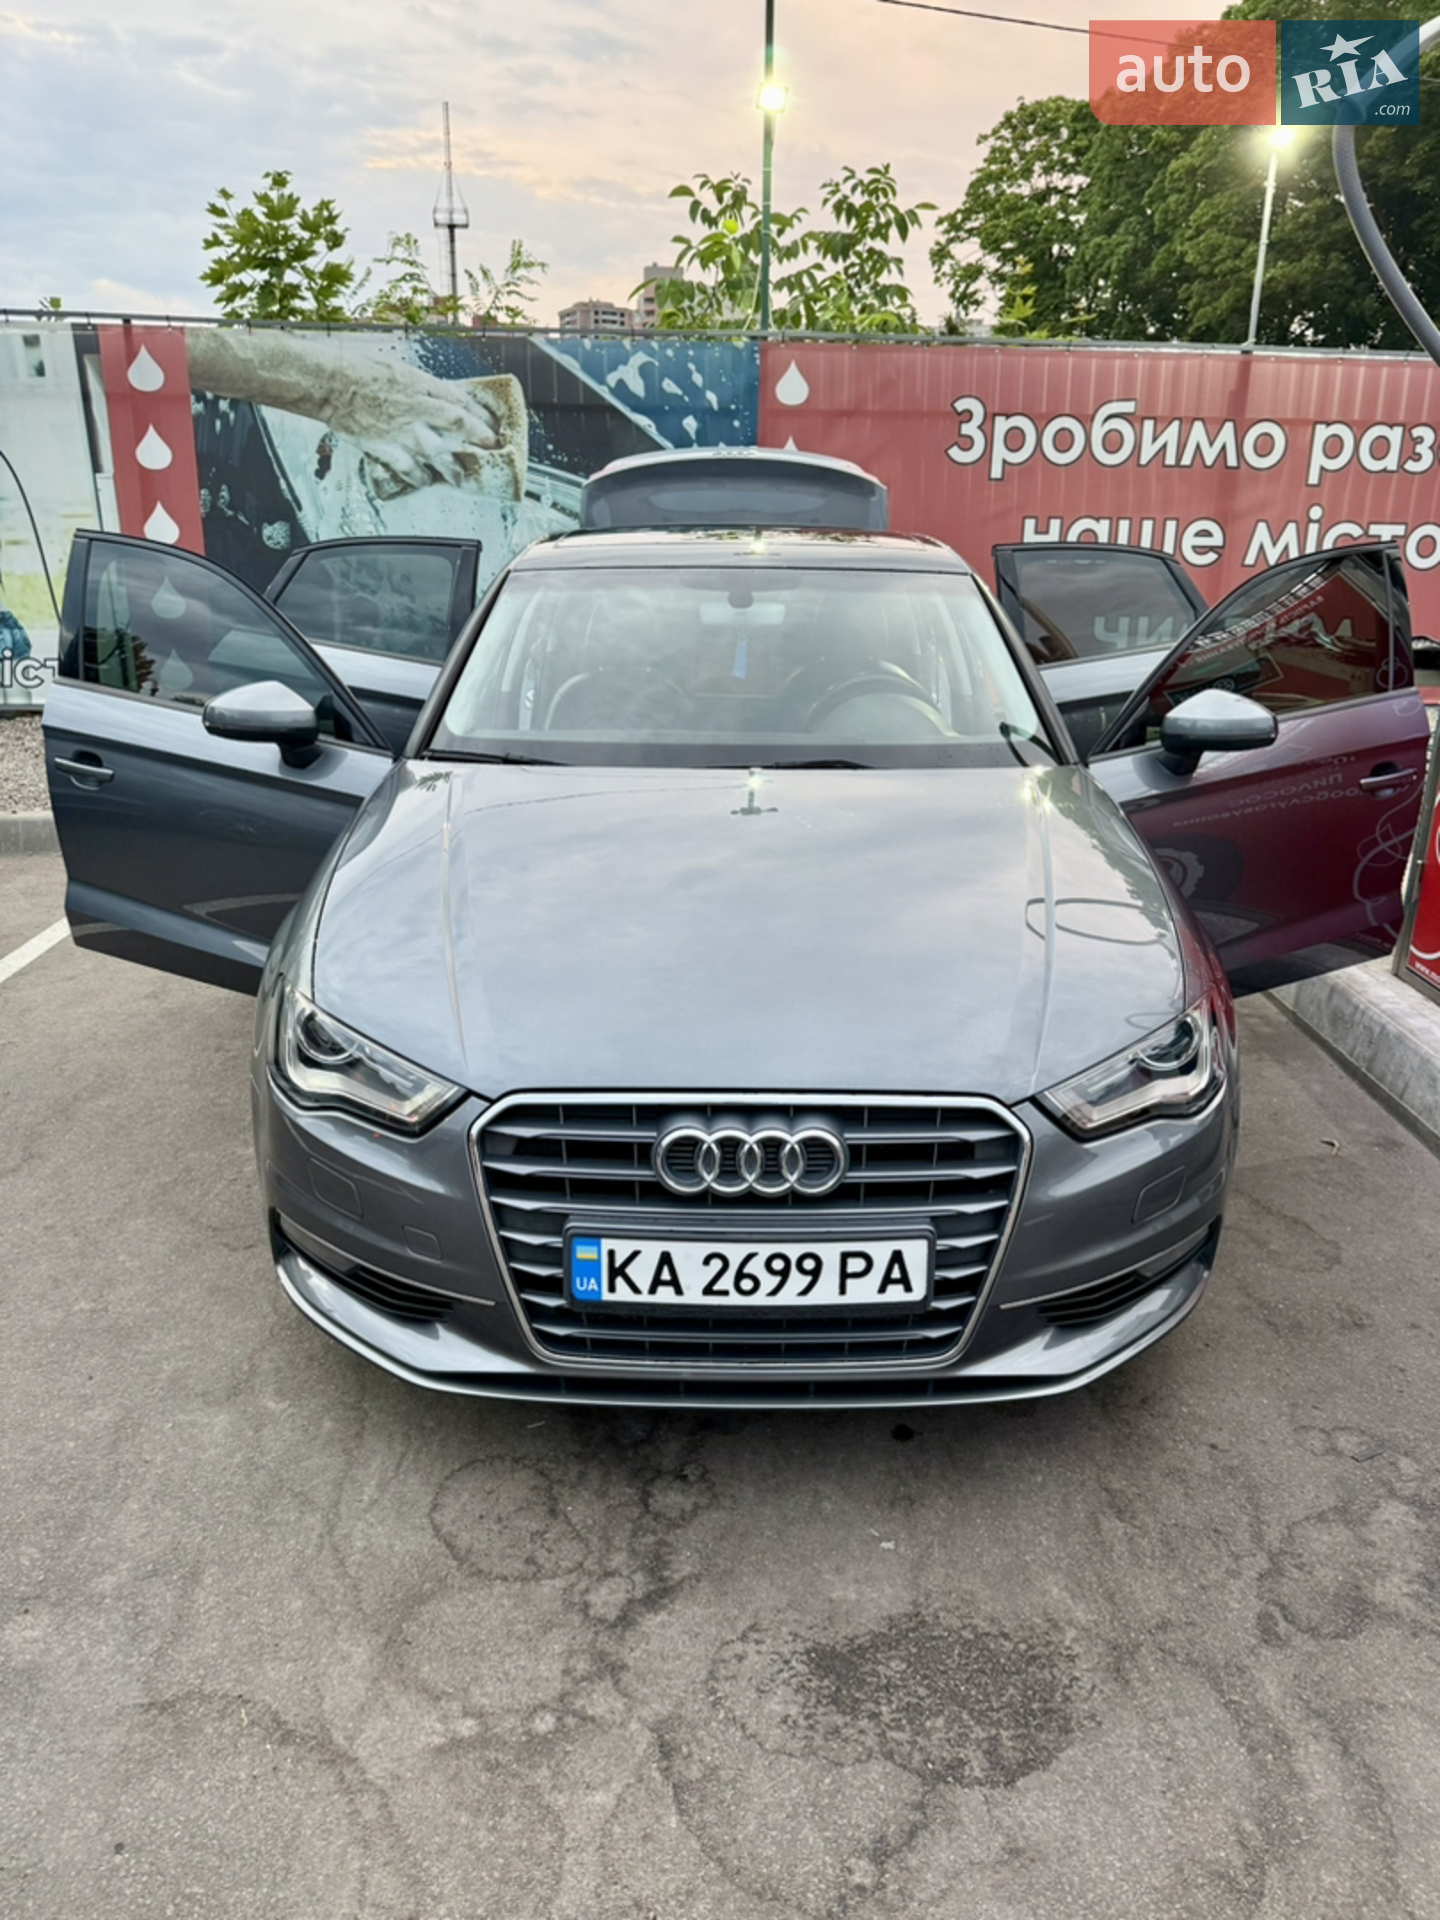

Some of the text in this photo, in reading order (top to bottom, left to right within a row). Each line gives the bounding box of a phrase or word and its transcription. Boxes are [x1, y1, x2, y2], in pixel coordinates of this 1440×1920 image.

[946, 394, 1440, 488] Зробимо раз
[576, 1276, 599, 1292] UA
[607, 1249, 914, 1297] KA 2699 PA
